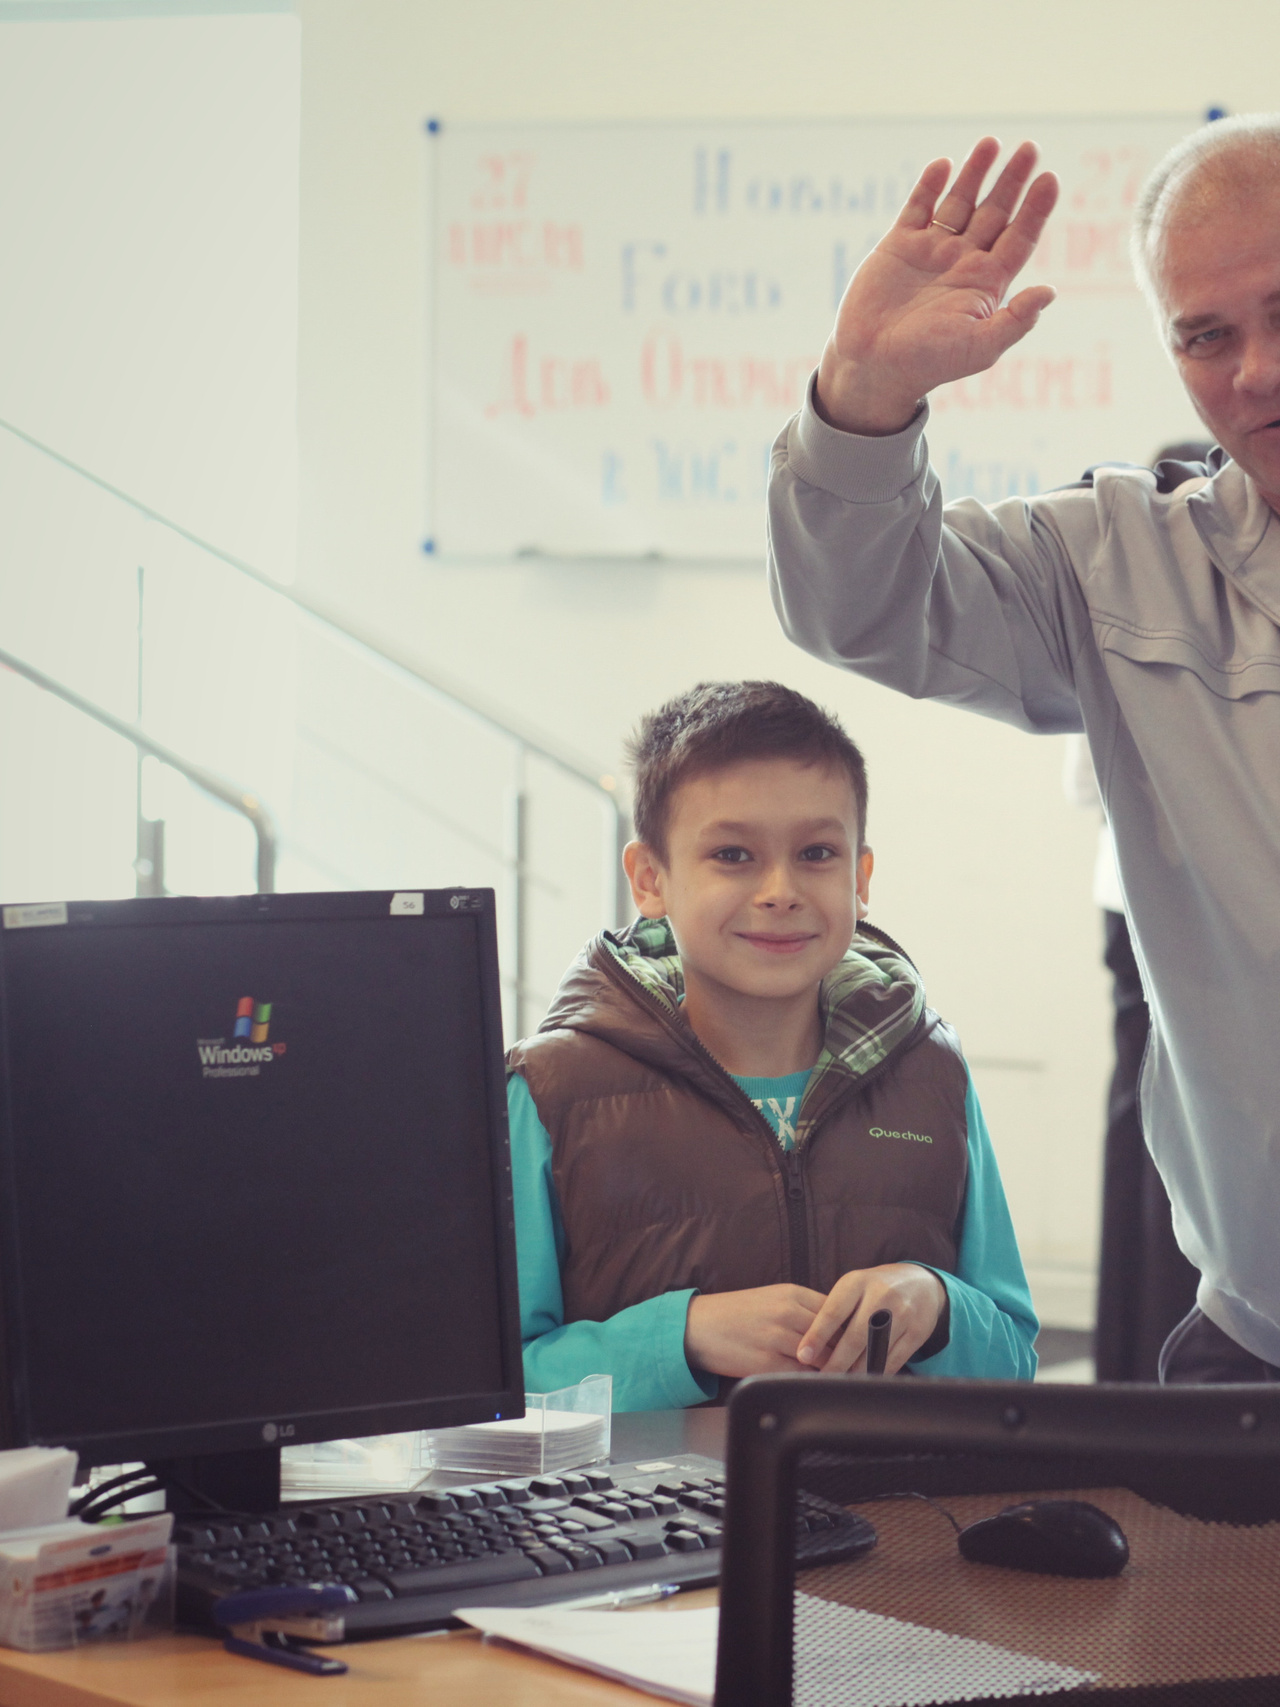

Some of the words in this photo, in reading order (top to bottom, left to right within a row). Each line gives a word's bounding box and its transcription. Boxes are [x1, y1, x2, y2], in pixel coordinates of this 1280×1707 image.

[198, 1044, 274, 1065] Windows
[868, 1127, 934, 1144] Quechua
[279, 1424, 295, 1437] LG
